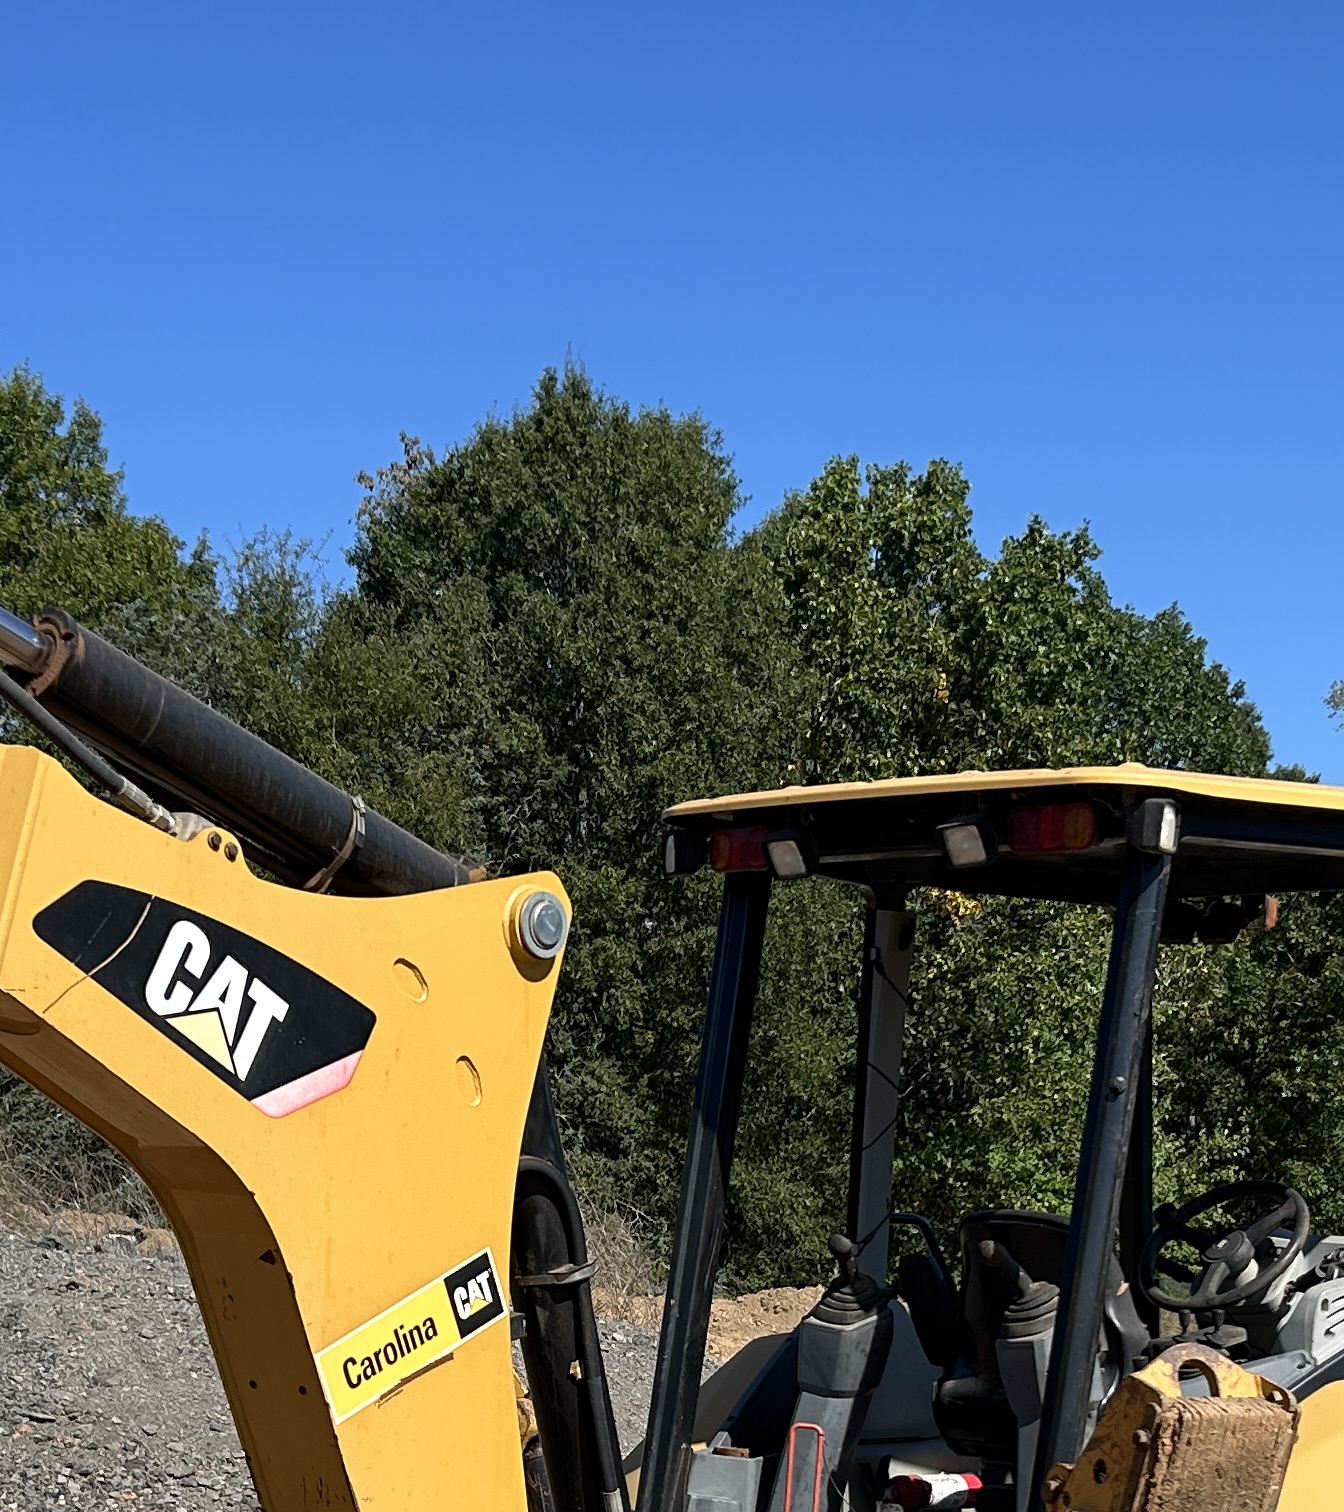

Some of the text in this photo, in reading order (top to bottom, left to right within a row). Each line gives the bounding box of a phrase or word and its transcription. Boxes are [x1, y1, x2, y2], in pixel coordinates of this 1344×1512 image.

[145, 919, 290, 1082] CAT
[342, 1268, 494, 1389] Carolina CAT
